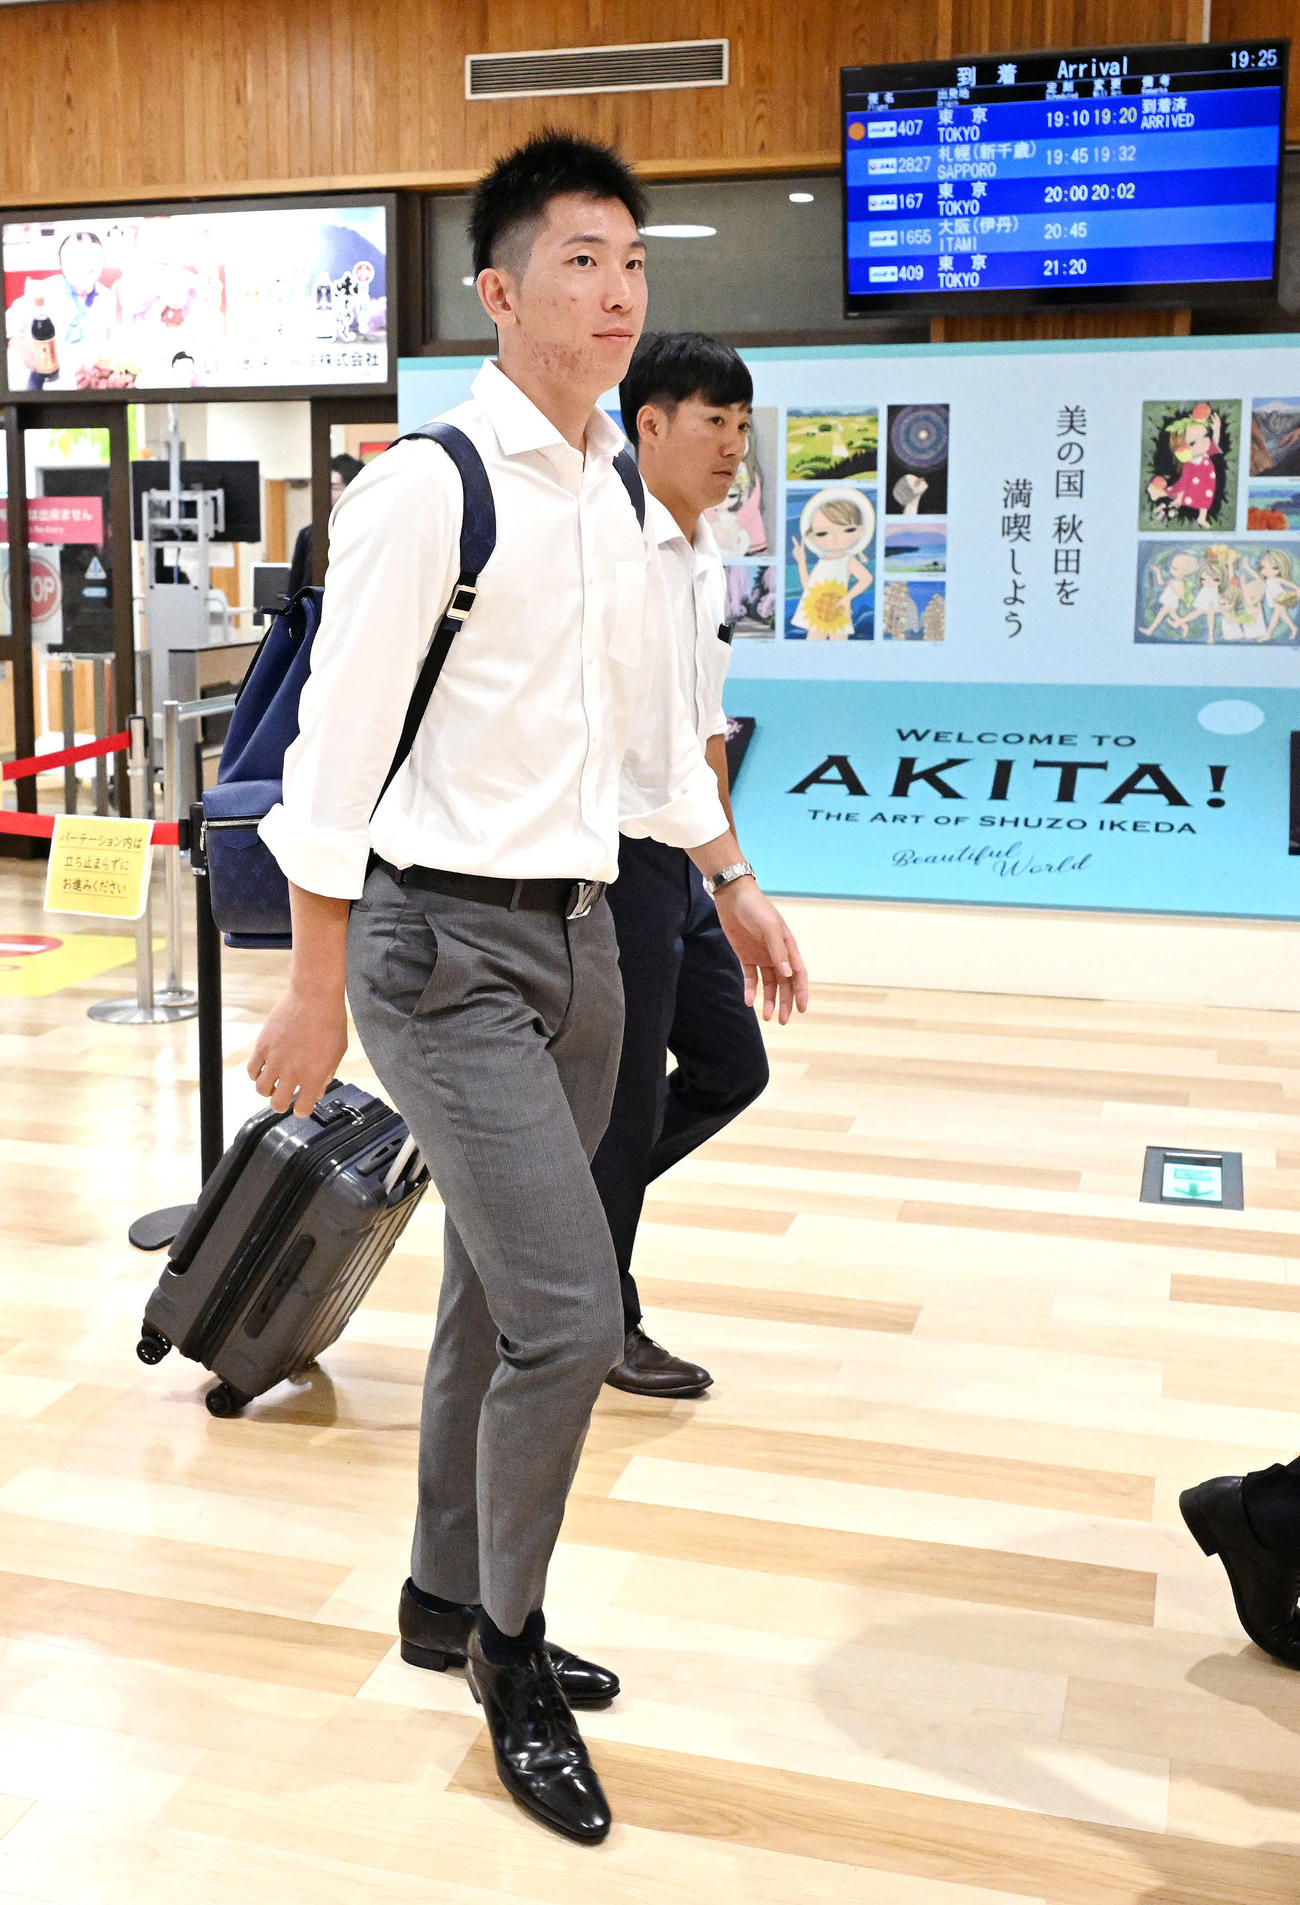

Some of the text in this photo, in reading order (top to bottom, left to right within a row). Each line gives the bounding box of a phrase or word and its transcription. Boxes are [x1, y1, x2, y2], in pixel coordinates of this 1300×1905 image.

[1057, 56, 1128, 79] Arrival
[1230, 49, 1278, 69] 19:25
[1142, 96, 1188, 114] 到着済
[1046, 107, 1138, 128] 19:10 19:20
[1140, 113, 1195, 130] ARRIVED
[897, 119, 923, 136] 407
[937, 125, 980, 143] TOKYO
[1046, 145, 1137, 165] 19:45 19:32
[898, 156, 931, 173] 2827
[937, 162, 997, 180] SAPPORO
[898, 193, 924, 209] 167
[1044, 182, 1136, 203] 20:00 20:02
[937, 200, 980, 217] TOKYO
[899, 229, 932, 245] 1655
[1044, 222, 1088, 240] 20:45
[939, 236, 977, 253] ITAMI
[898, 265, 924, 281] 409
[1043, 258, 1087, 276] 21:20
[937, 272, 980, 288] TOKYO
[1052, 404, 1087, 606] 美の国 秋田を
[1001, 478, 1033, 638] 満喫しよう
[896, 728, 1137, 748] WELCOME TO
[785, 755, 1230, 808] AKITA!
[808, 809, 1197, 834] THE ART OF SHUZO IKEDA
[60, 832, 142, 849] パーテーション内は
[64, 855, 130, 871] 立ち止まらずに
[891, 841, 1023, 867] Beautiful
[992, 853, 1093, 877] World
[63, 878, 127, 894] お進みください
